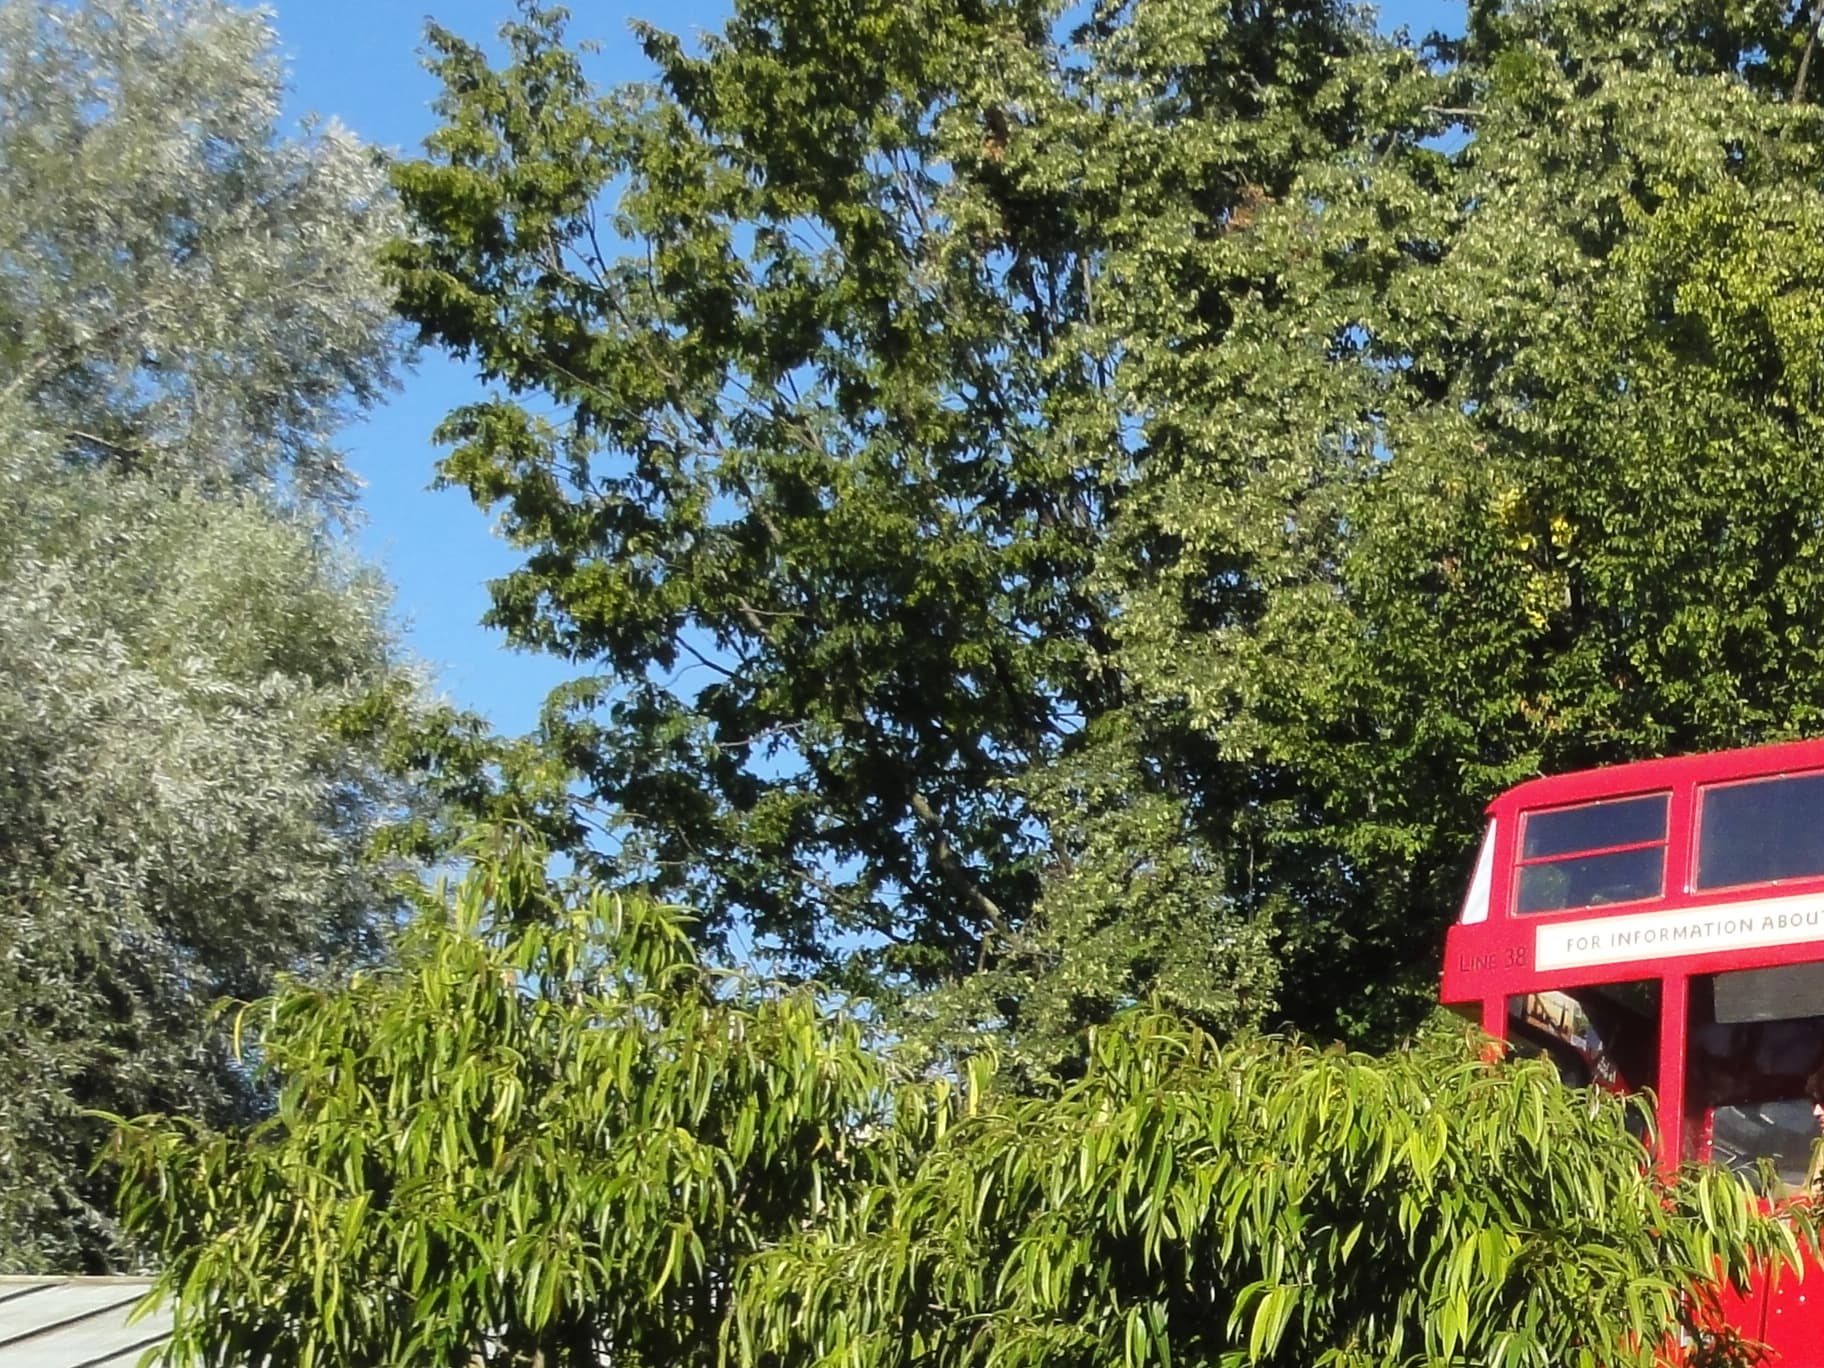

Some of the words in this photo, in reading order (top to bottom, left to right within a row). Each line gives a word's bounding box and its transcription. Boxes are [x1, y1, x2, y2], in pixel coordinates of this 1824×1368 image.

[1567, 934, 1601, 953] FOR
[1610, 917, 1753, 948] INFORMATION
[1503, 946, 1528, 969] 38
